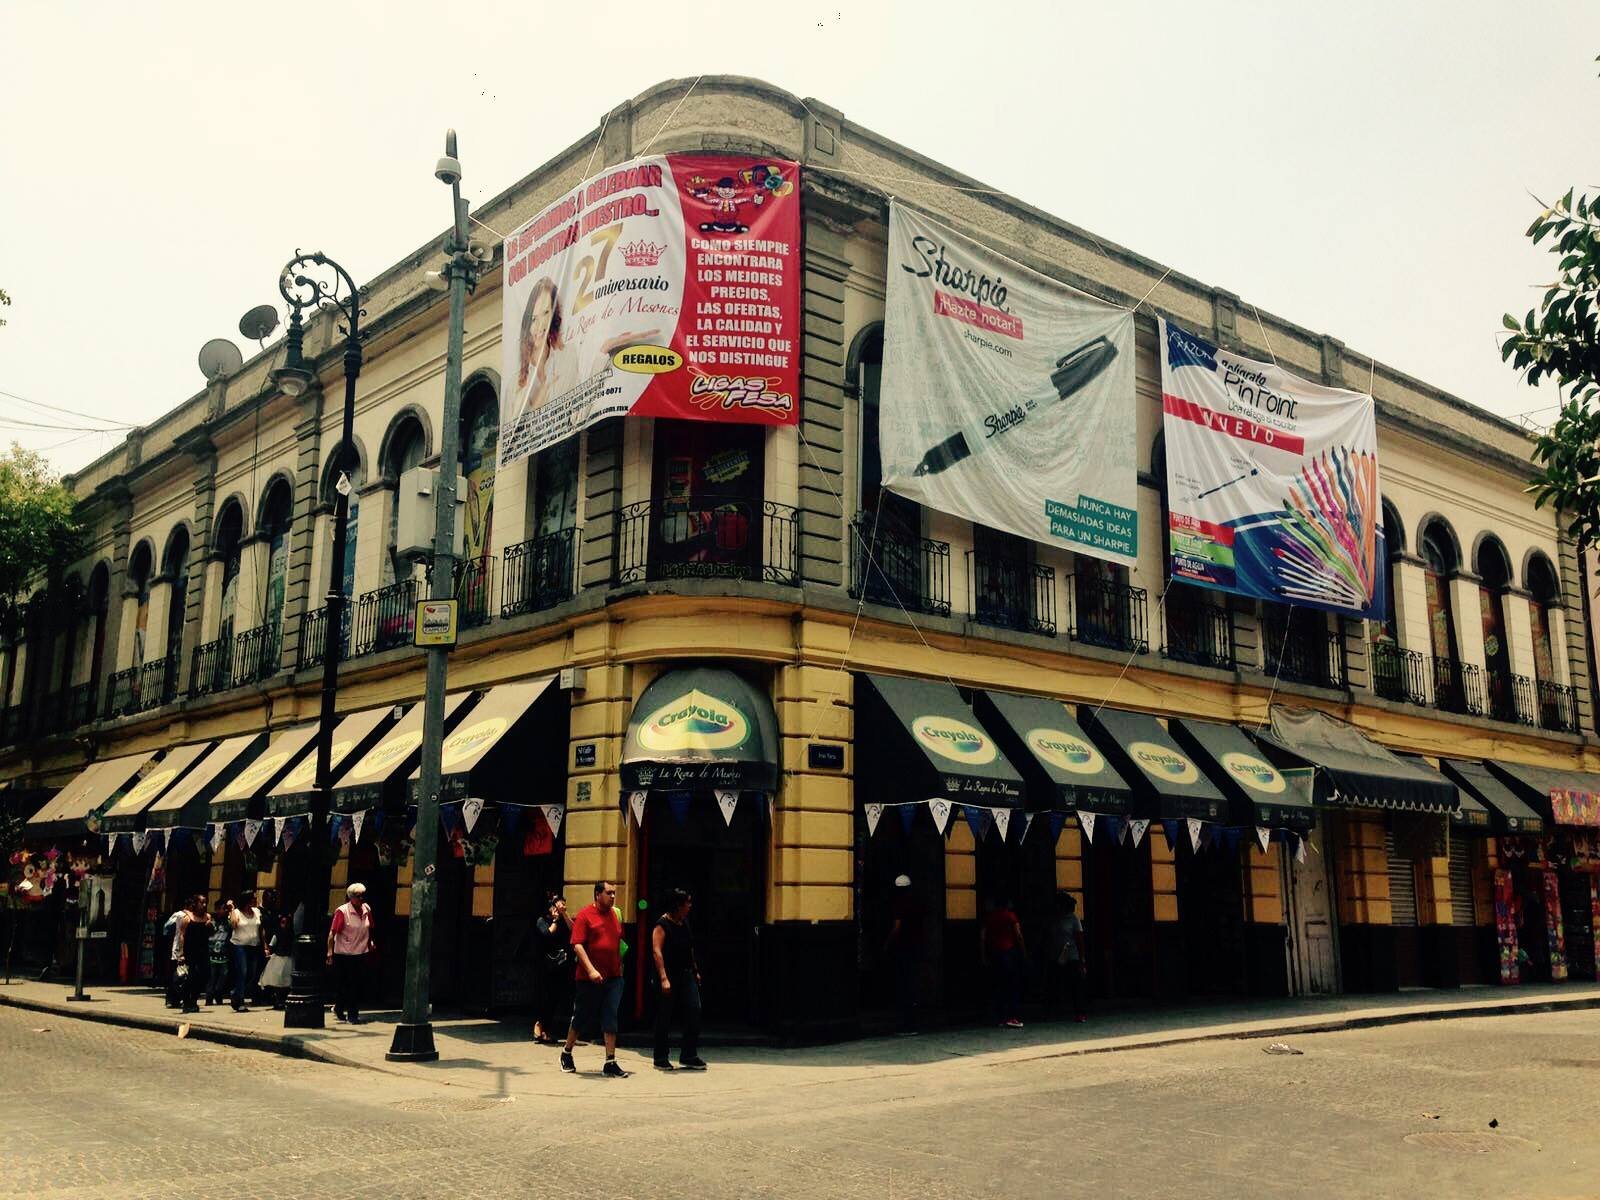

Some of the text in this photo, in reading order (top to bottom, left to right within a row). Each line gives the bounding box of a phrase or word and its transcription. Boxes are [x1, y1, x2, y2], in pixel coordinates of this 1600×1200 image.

[691, 238, 789, 255] COMO SIEMPRE
[697, 253, 784, 270] ENCONTRARA
[697, 269, 783, 286] LOS MEJORES
[901, 235, 1010, 314] Sharpie
[595, 275, 669, 300] aniversario
[620, 296, 678, 316] Mesones
[697, 302, 782, 320] LAS OFERTAS,
[697, 318, 782, 335] LA CALIDAD Y
[686, 335, 792, 352] EL SERVICIO QUE
[964, 329, 1013, 358] sharpie.com
[622, 353, 675, 366] REGALOS
[688, 351, 789, 368] NOS DISTINGUE
[691, 376, 766, 395] LIGAS
[722, 390, 792, 410] FESA
[984, 404, 1026, 439] Sharpie
[1079, 497, 1132, 521] NUNCA HAY
[1047, 503, 1132, 538] DEMASIADAS IDEAS
[1052, 522, 1133, 553] PARA UN SHARPIE.
[657, 704, 729, 727] Crayola
[922, 726, 978, 742] Crayola
[1037, 738, 1088, 753] Crayola
[1137, 751, 1181, 765] Crayola
[658, 767, 669, 778] La
[699, 762, 709, 778] de
[1230, 761, 1269, 775] Crayola
